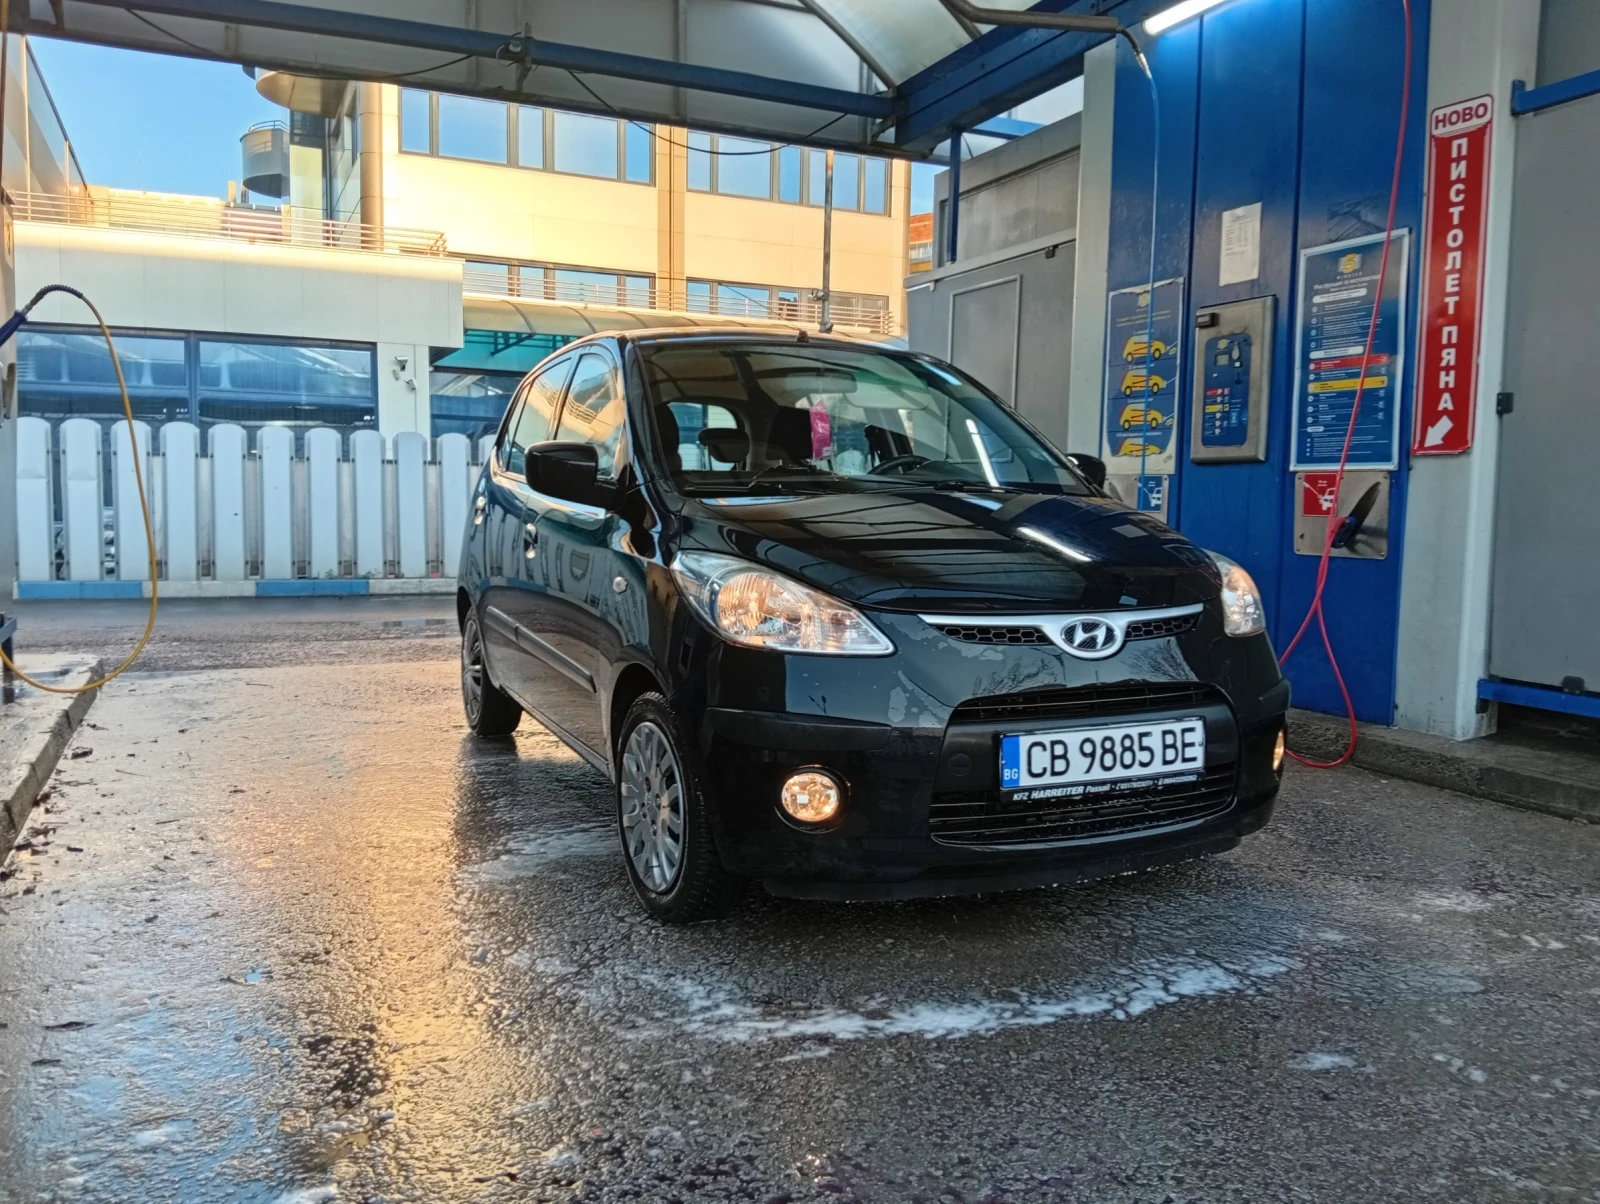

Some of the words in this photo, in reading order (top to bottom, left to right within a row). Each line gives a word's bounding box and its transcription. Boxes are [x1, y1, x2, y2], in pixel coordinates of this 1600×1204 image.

[1434, 102, 1488, 131] НОВО
[1443, 137, 1468, 315] ПИСТОЛЕТ
[1437, 325, 1458, 411] ПЯНА
[1026, 739, 1070, 778] CB
[1079, 731, 1155, 775] 9885
[1161, 727, 1198, 766] BE
[1003, 768, 1019, 781] BG
[1013, 791, 1029, 801] KFZ
[1030, 786, 1085, 799] HARREITER
